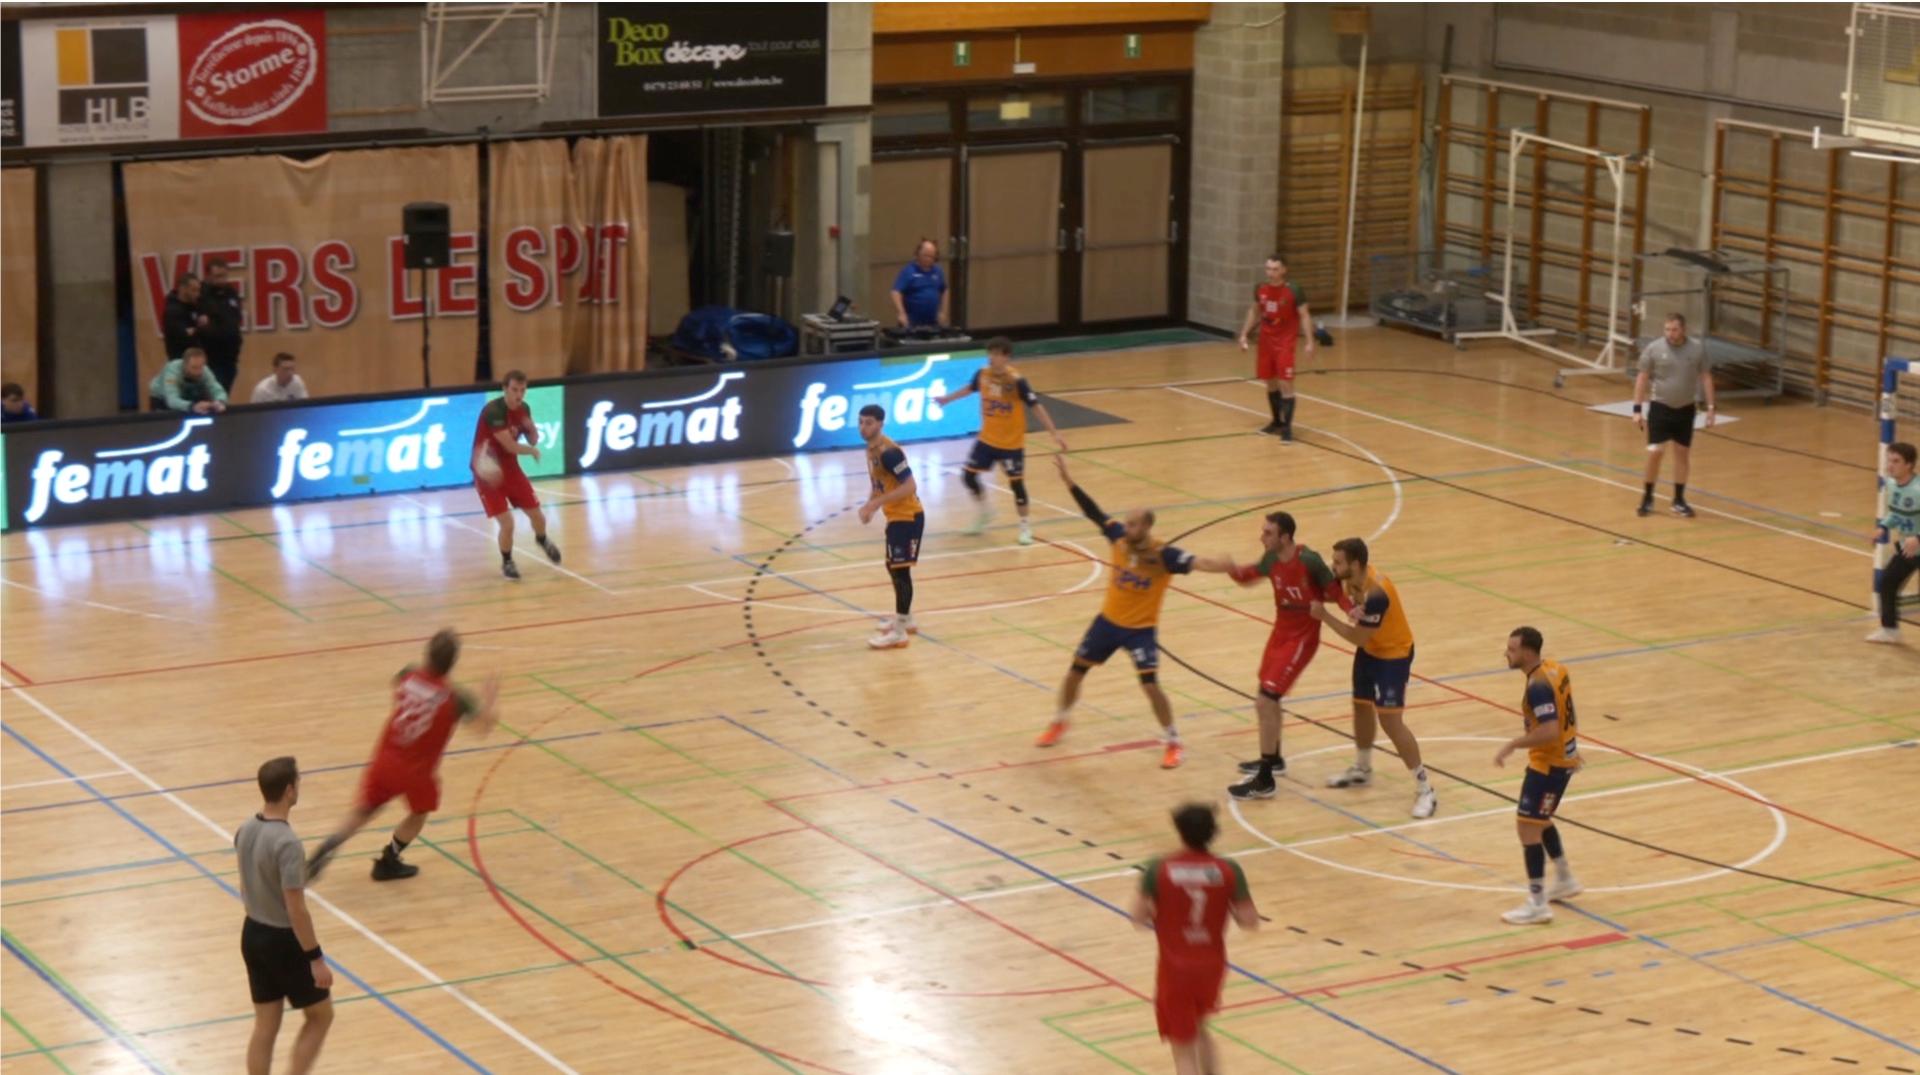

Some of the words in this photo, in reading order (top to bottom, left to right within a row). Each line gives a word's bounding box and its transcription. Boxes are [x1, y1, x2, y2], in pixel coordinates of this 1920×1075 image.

[608, 17, 669, 42] Deco
[615, 42, 664, 66] Box
[664, 41, 747, 70] décape
[210, 48, 296, 95] Storme
[86, 97, 149, 123] HLB
[141, 240, 358, 339] VERS
[388, 232, 478, 320] LE
[580, 395, 741, 468] femat
[793, 378, 946, 448] femat
[24, 444, 211, 523] femat
[270, 422, 446, 498] femat
